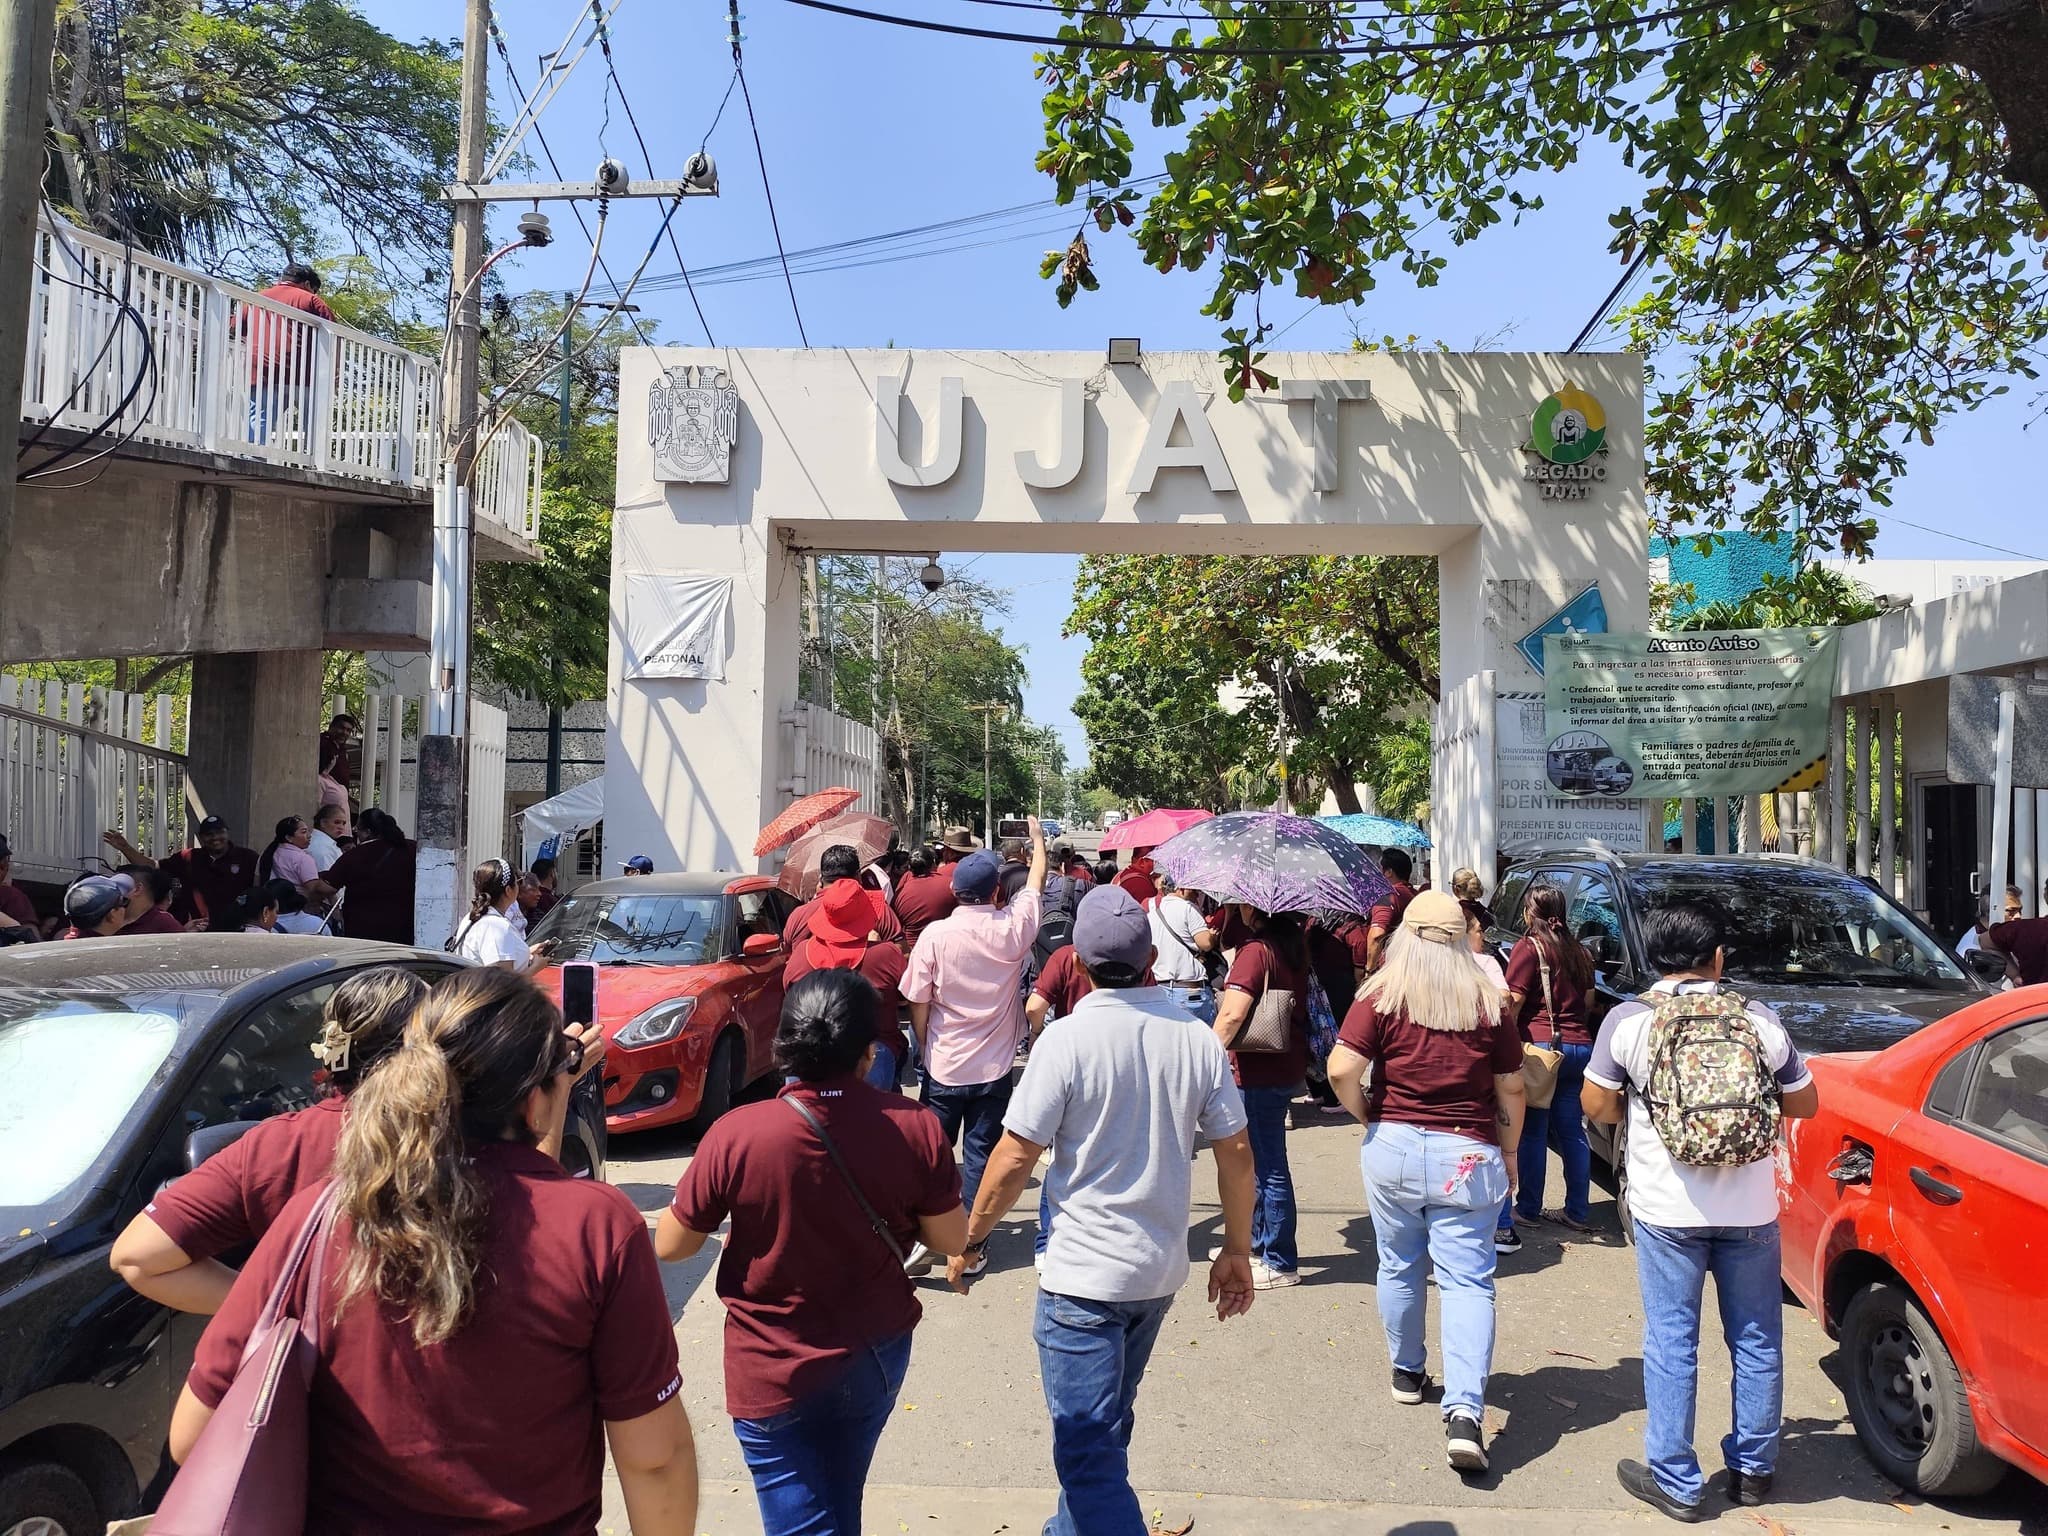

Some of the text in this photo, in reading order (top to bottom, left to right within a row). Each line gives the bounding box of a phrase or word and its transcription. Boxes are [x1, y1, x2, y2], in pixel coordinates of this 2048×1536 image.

[876, 375, 1371, 494] UJAT
[1524, 464, 1607, 480] LEGADO
[1540, 483, 1592, 500] UJAT
[1647, 634, 1759, 652] Atento Aviso
[644, 654, 705, 665] PEATONAL
[1572, 661, 1594, 669] Para
[1598, 660, 1638, 671] ingresar
[1650, 659, 1664, 667] las
[1668, 657, 1732, 667] instalaciones
[1735, 655, 1804, 665] universitarias
[1648, 669, 1693, 678] necesario
[1697, 668, 1746, 679] presentar:
[1569, 685, 1613, 693] Credencial
[1617, 686, 1633, 695] que
[1645, 683, 1679, 691] acredite
[1707, 681, 1755, 690] estudiante,
[1757, 680, 1792, 690] profesor
[1570, 693, 1677, 704] trabajador universitario.
[1600, 705, 1641, 714] visitante,
[1663, 703, 1720, 714] identificación
[1723, 703, 1749, 713] oficial
[1751, 702, 1775, 712] (INE),
[1571, 717, 1609, 726] informar
[1612, 717, 1625, 725] del
[1627, 716, 1647, 724] área
[1689, 715, 1702, 724] y/o
[1705, 714, 1736, 722] trámite
[1642, 742, 1694, 751] Familiares
[1706, 740, 1739, 751] padres
[1741, 740, 1751, 748] de
[1751, 738, 1782, 750] familia
[1784, 738, 1795, 746] de
[1642, 752, 1703, 761] estudiantes,
[1706, 750, 1744, 759] deberán
[1745, 749, 1778, 759] dejarlos
[1793, 748, 1801, 756] la
[1643, 761, 1682, 770] entrada
[1684, 760, 1726, 772] peatonal
[1753, 758, 1788, 767] División
[1643, 772, 1700, 781] Académica.
[1501, 779, 1530, 790] POR
[1500, 820, 1641, 831] PRESENTE SU CREDENCIAL
[1500, 832, 1507, 840] O
[1600, 832, 1641, 842] OFICIAL
[657, 1375, 680, 1401] UJAT
